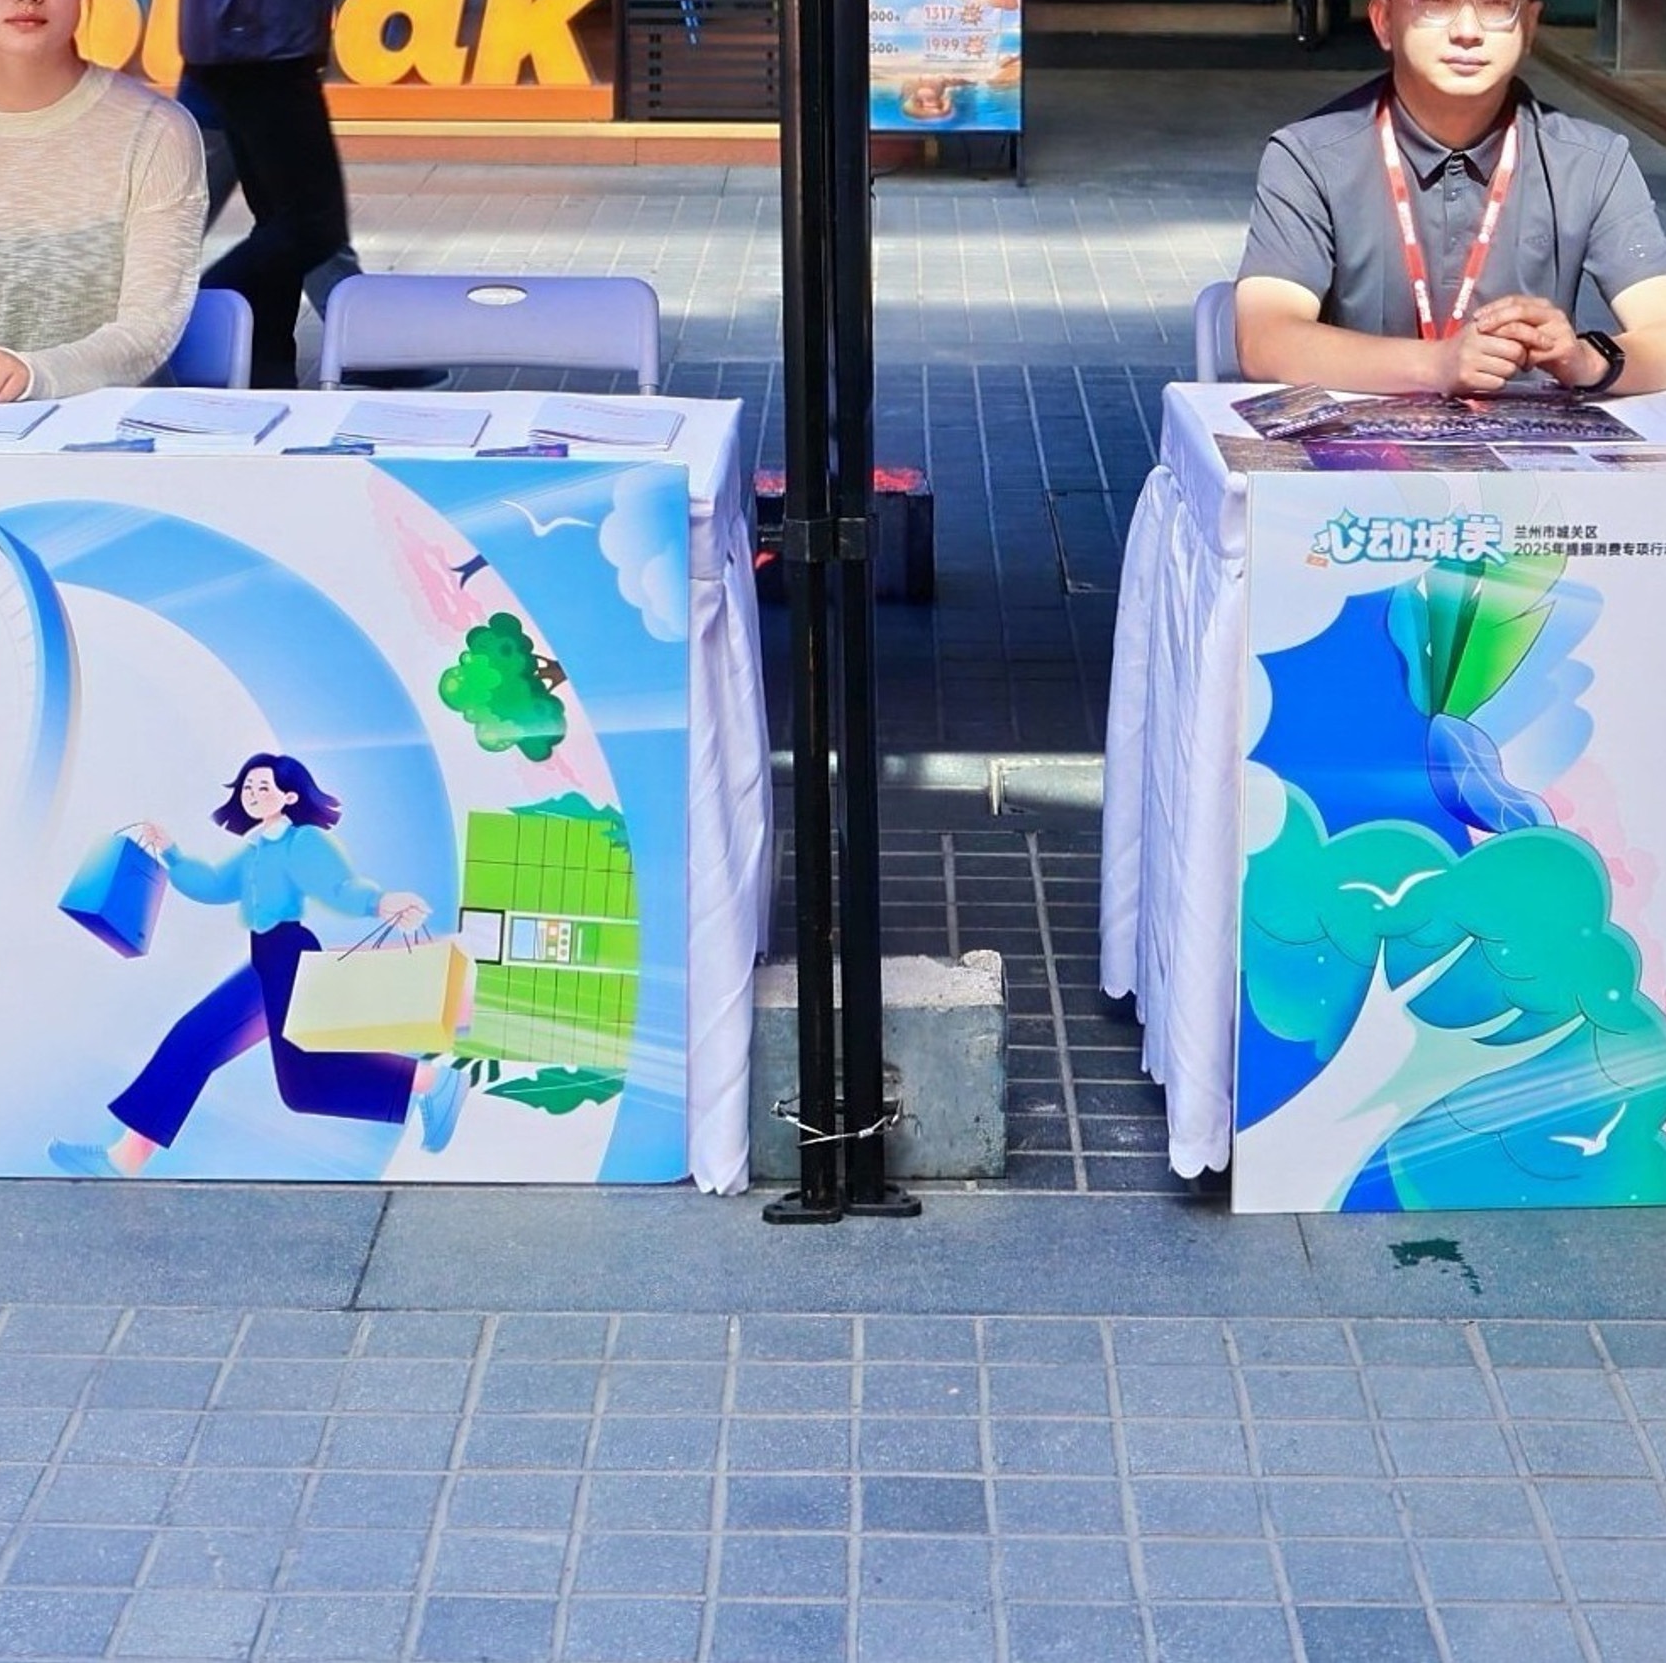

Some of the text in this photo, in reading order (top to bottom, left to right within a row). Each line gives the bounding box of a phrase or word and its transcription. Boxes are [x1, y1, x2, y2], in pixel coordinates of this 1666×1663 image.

[1312, 507, 1511, 567] 心动城关
[1514, 525, 1598, 539] 兰州市城关区
